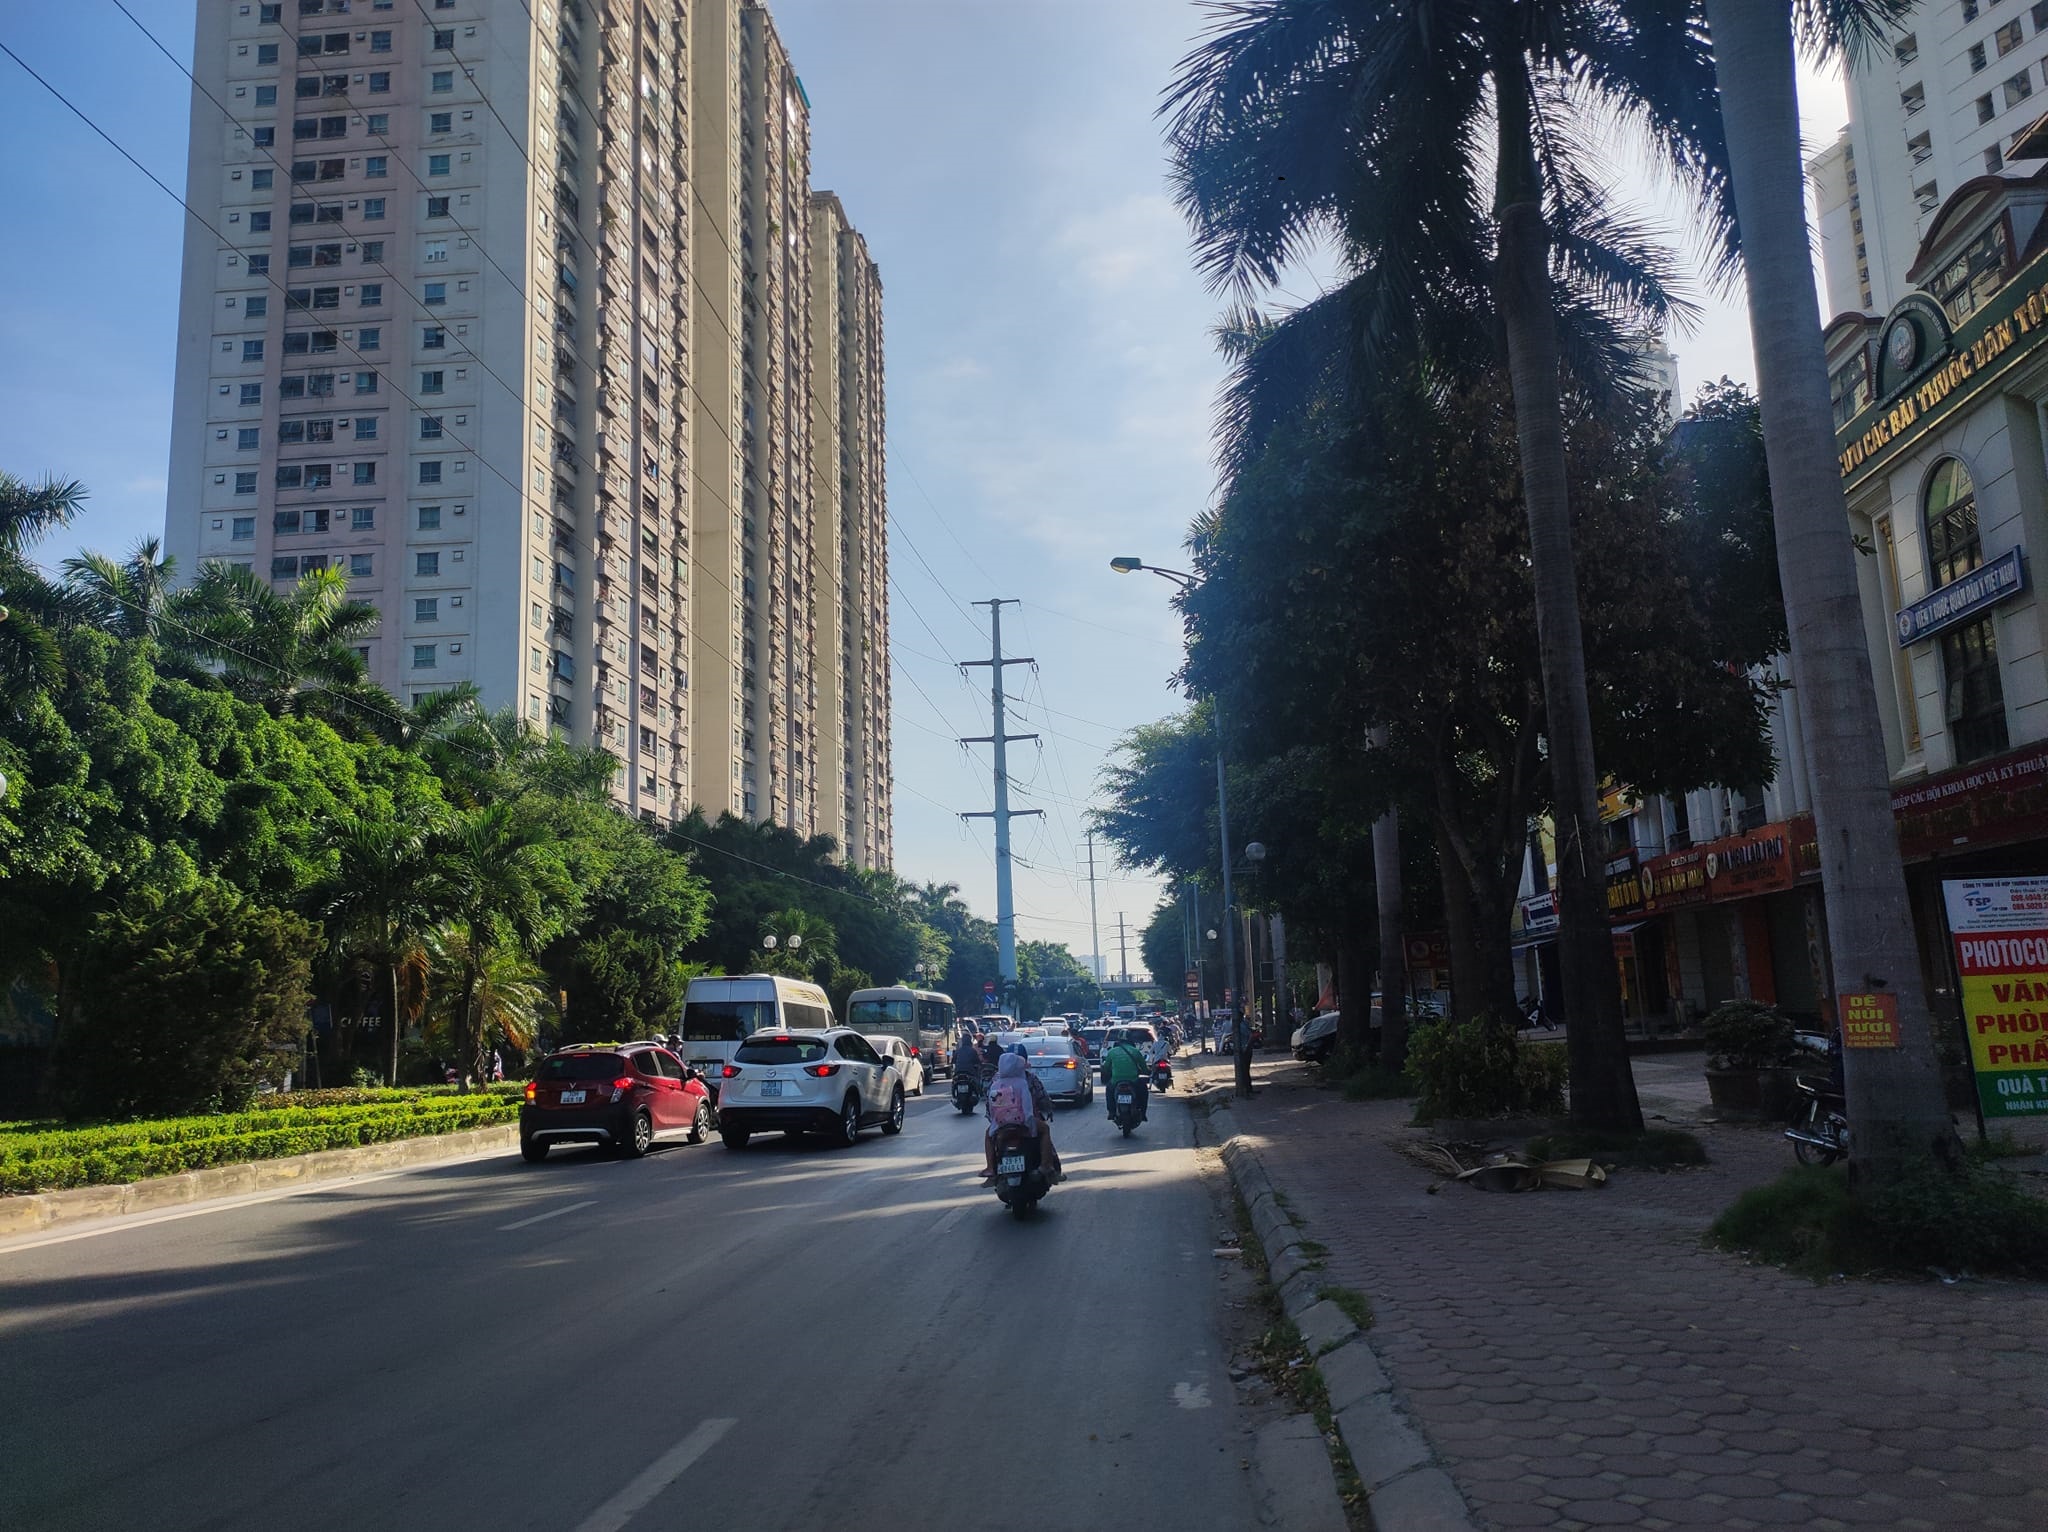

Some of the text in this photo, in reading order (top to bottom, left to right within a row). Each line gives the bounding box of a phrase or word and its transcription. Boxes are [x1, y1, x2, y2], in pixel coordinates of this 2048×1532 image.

[1863, 421, 1890, 456] CÁC
[1888, 398, 1919, 437] BÀI
[1916, 348, 1974, 413] THUỐC
[1911, 788, 1927, 803] CÁC
[1941, 781, 1966, 796] KHOA
[1966, 774, 1986, 789] HỌC
[1985, 767, 1999, 783] VÀ
[1965, 897, 1992, 907] TSP
[1960, 937, 2048, 969] PHOTOCO
[1850, 994, 1877, 1008] DÊ
[340, 1016, 382, 1028] CFEE
[1847, 1022, 1892, 1033] TƯƠI
[1997, 1074, 2035, 1096] QUÀ
